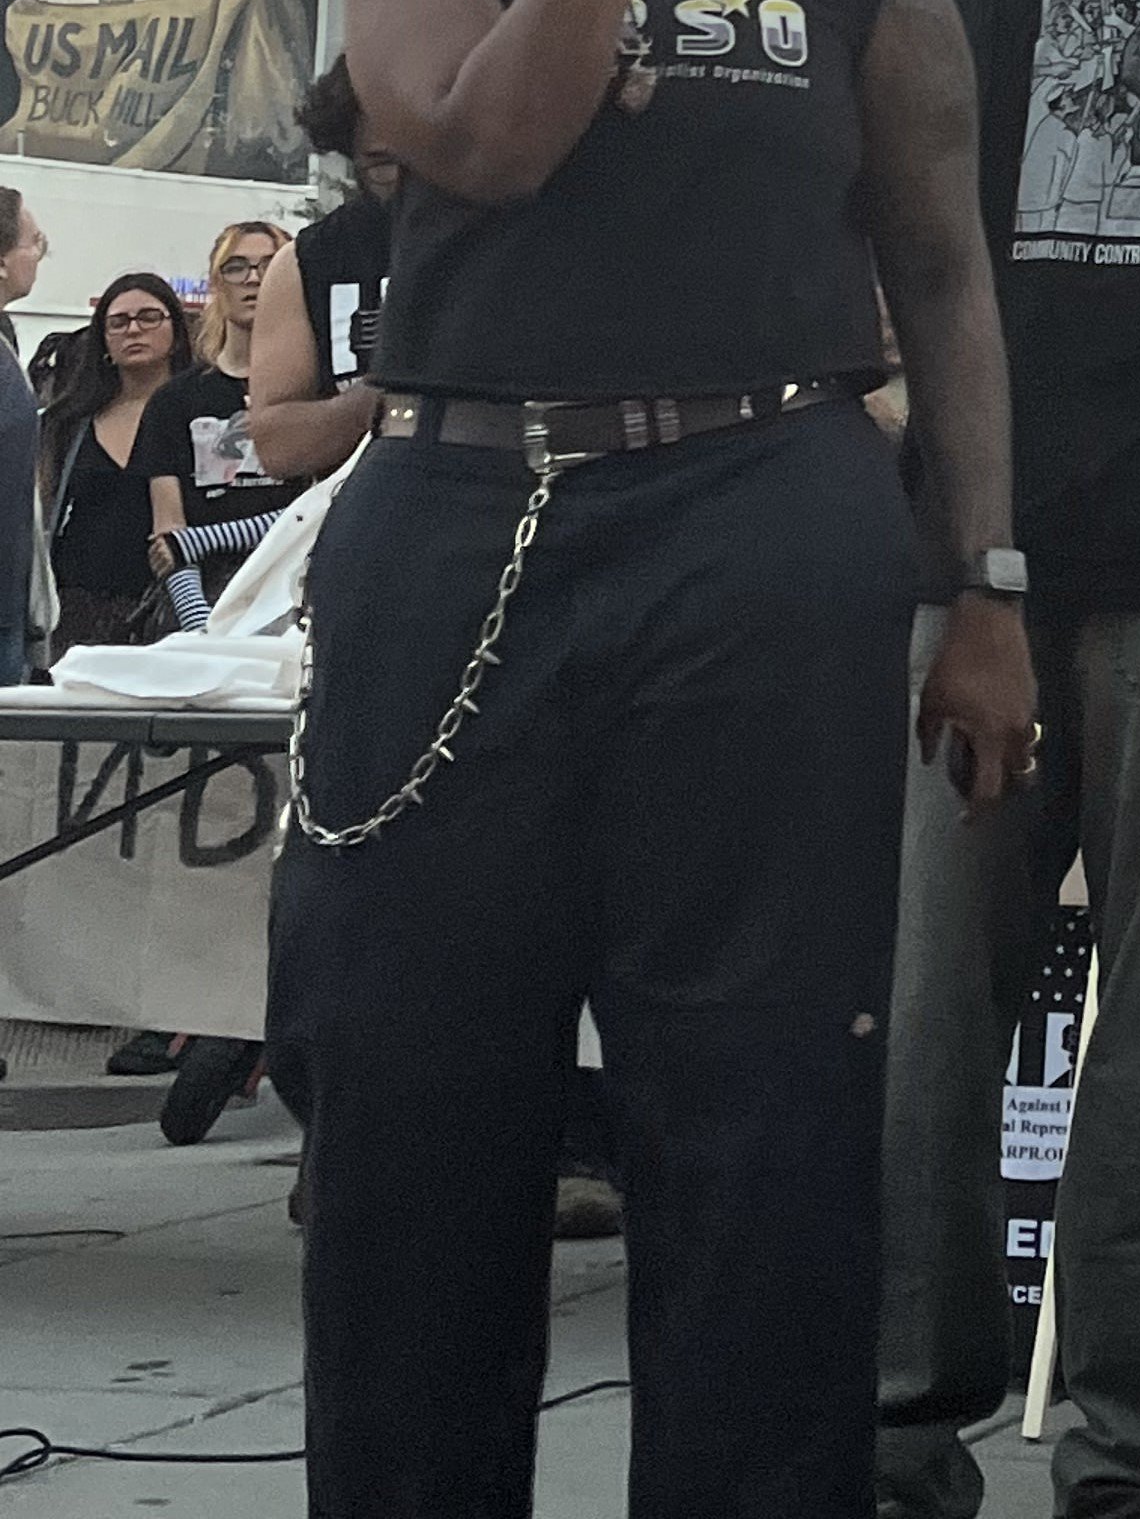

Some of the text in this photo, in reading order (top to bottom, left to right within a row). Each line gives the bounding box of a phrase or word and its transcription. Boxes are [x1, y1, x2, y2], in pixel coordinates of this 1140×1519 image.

[23, 16, 197, 84] US MAIL
[29, 84, 104, 127] BUCK
[1012, 239, 1092, 263] COMMUNITY
[1007, 1098, 1062, 1114] Against
